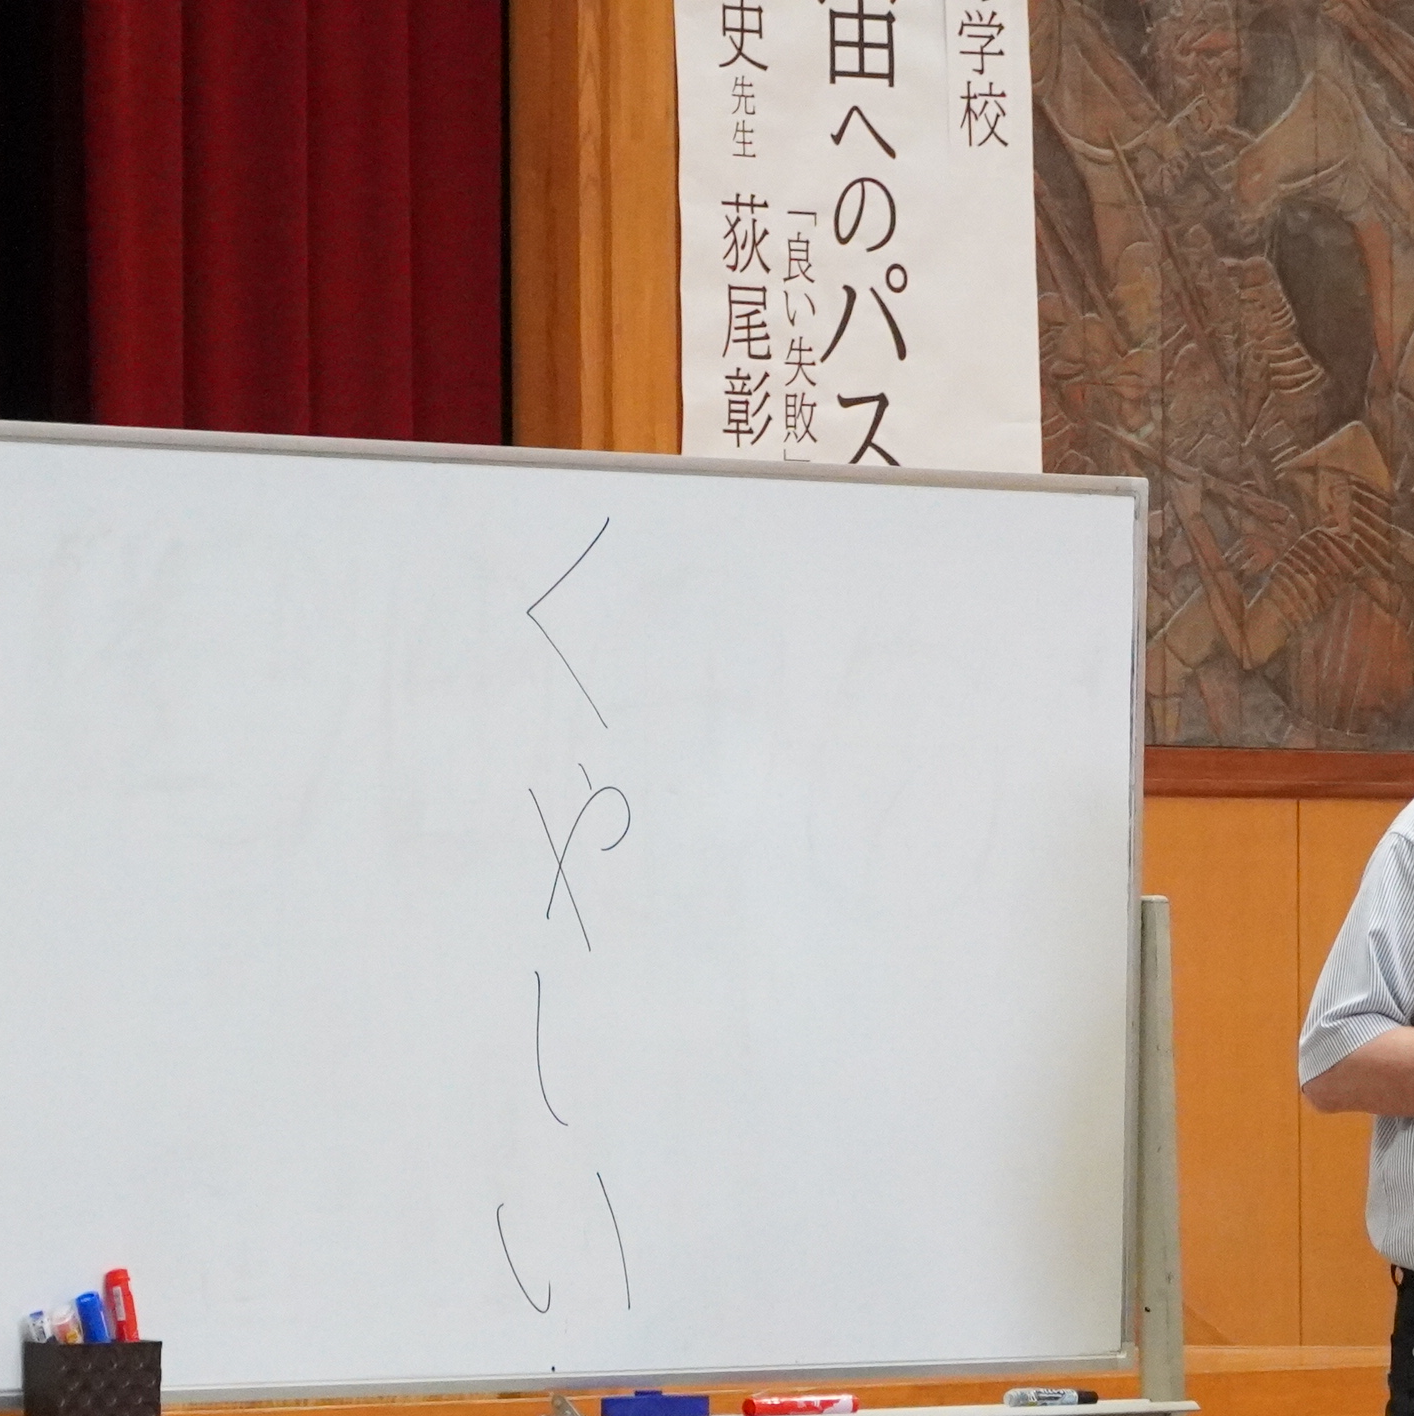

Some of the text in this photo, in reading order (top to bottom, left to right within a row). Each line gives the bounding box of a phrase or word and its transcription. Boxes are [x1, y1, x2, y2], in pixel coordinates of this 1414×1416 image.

[958, 10, 1009, 147] 学校
[721, 193, 773, 447] 荻尾彰
[496, 518, 631, 1313] くやしい
